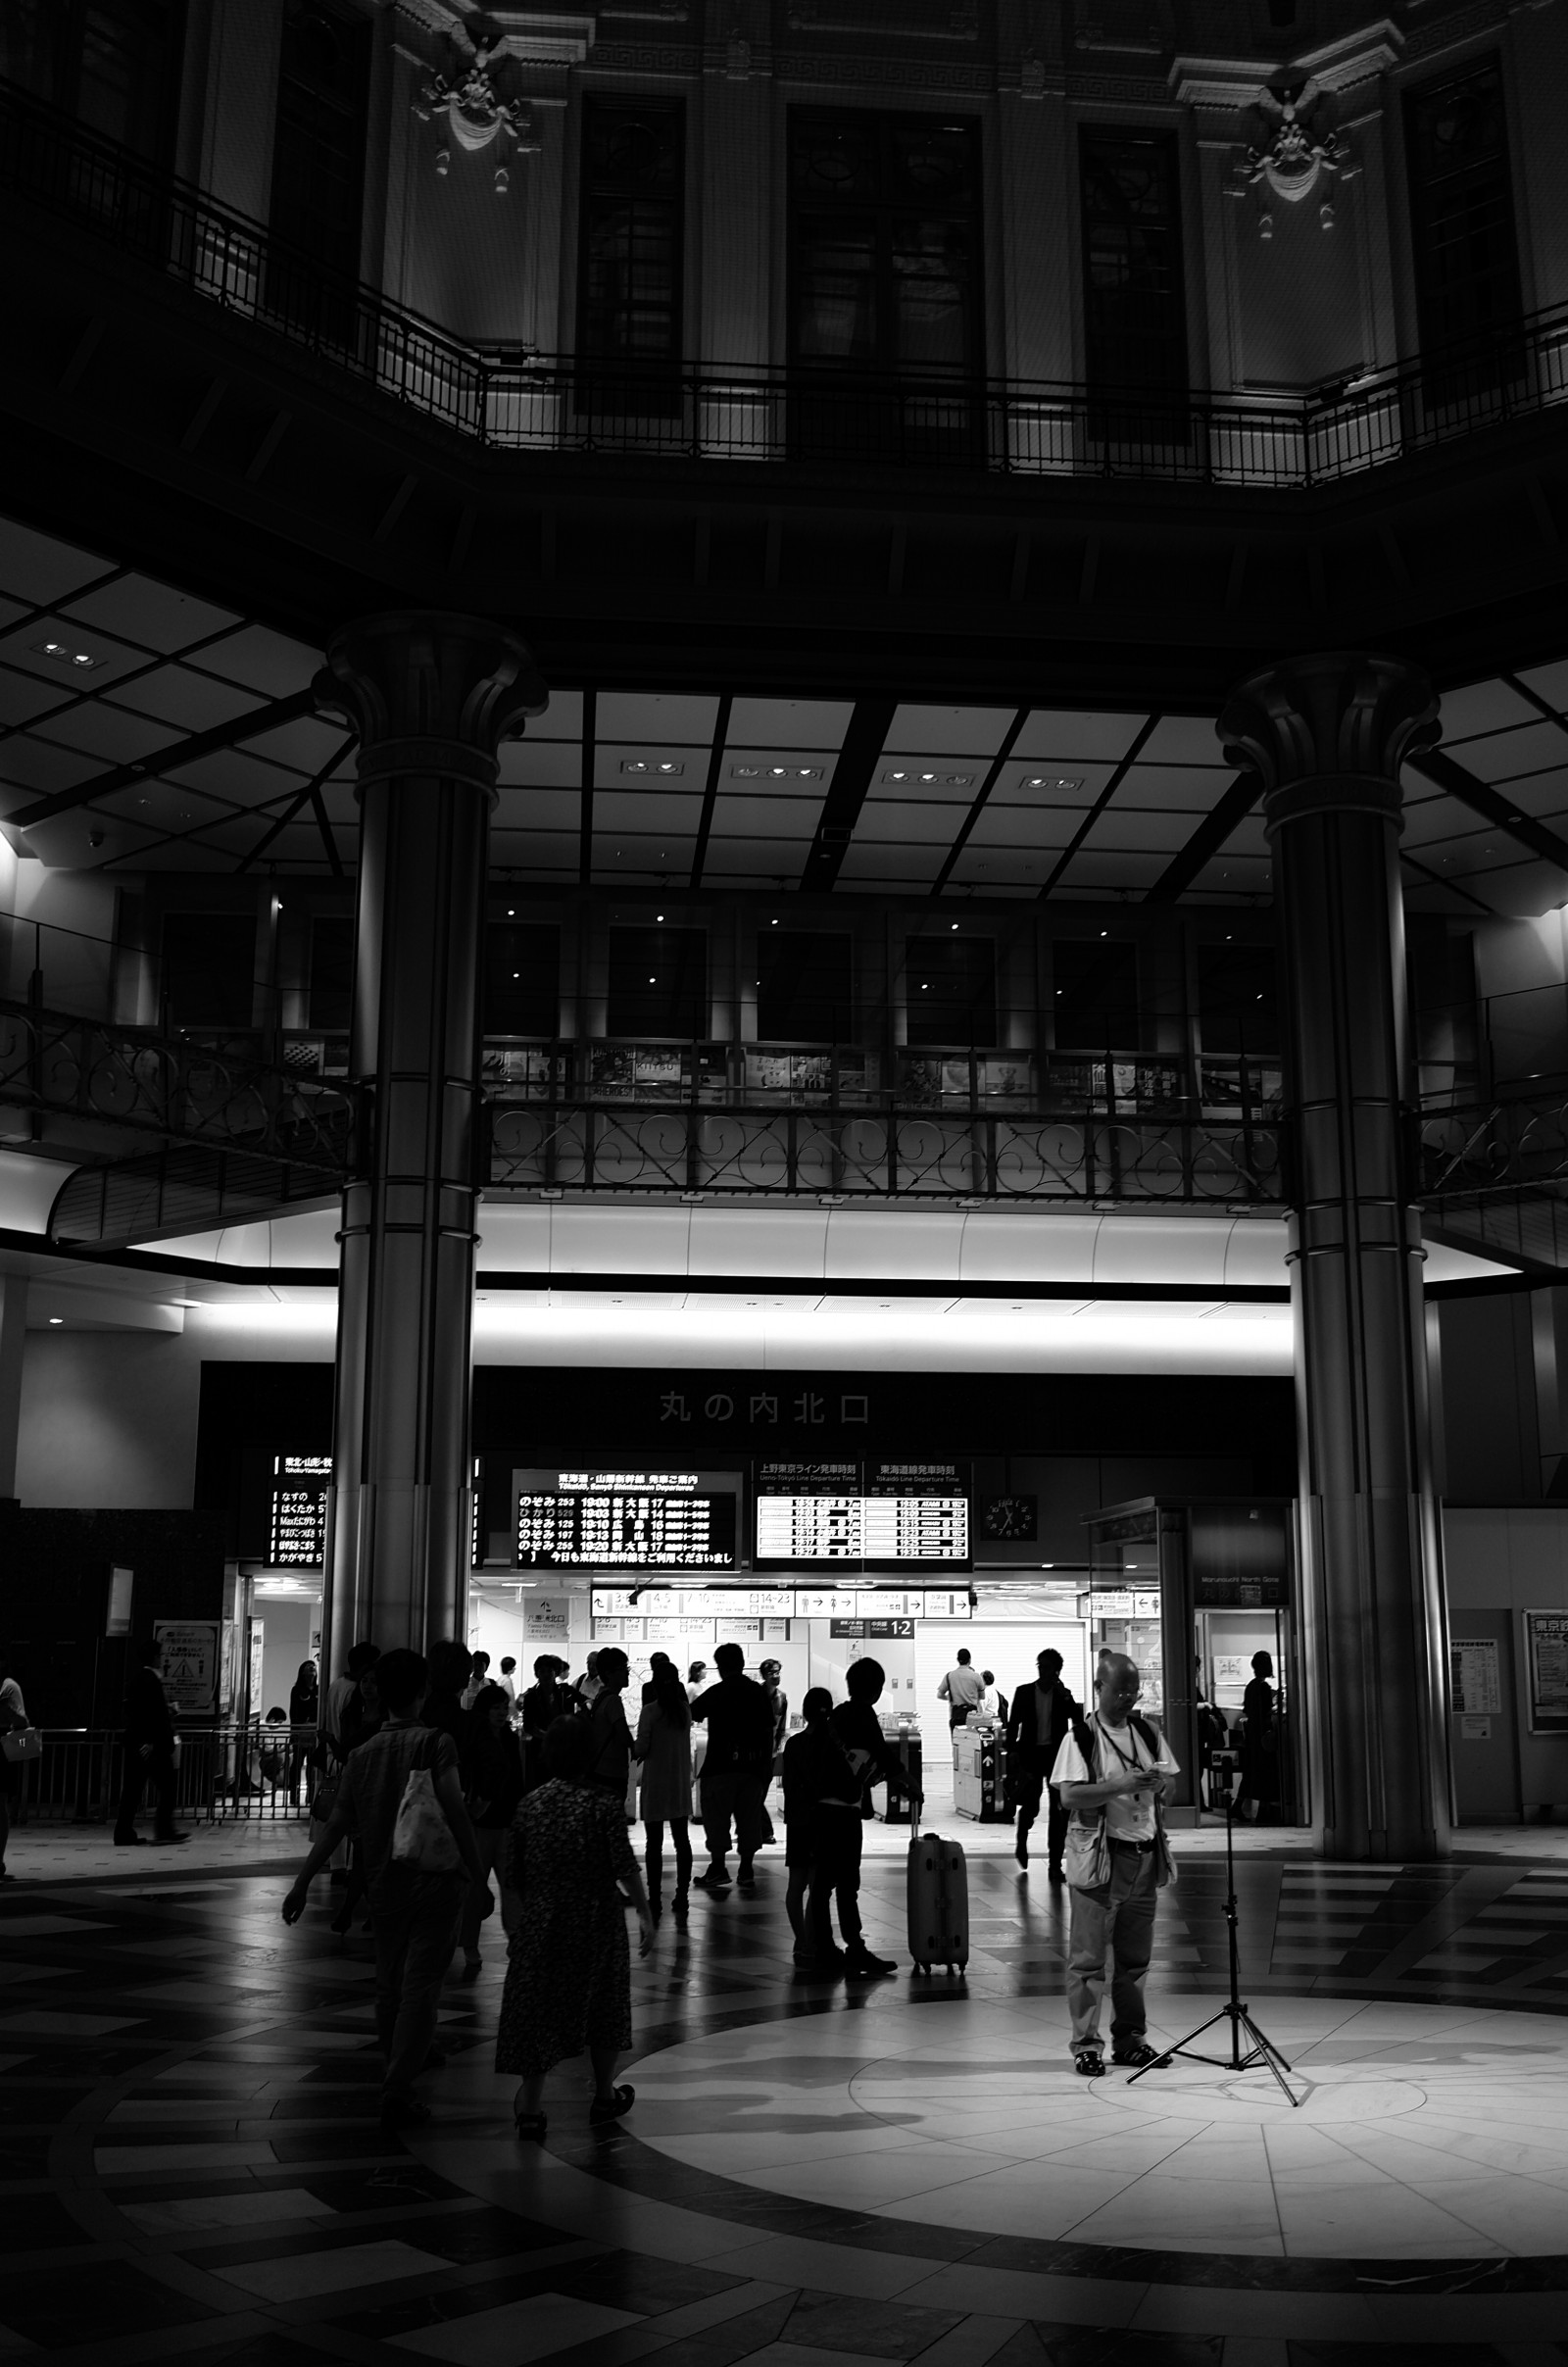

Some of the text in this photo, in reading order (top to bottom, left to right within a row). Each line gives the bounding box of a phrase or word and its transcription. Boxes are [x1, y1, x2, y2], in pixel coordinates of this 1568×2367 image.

[661, 1390, 869, 1424] 丸の内北口
[760, 1464, 857, 1474] 上野東京ライン発車時刻
[880, 1465, 956, 1475] 東海道線発車時刻
[282, 1493, 308, 1502] なすの
[519, 1497, 556, 1506] のぞみ
[581, 1498, 610, 1507] 19:00
[652, 1499, 663, 1507] 17
[281, 1504, 315, 1513] はくたか
[519, 1508, 555, 1517] ひかり
[581, 1508, 610, 1518] 19:03
[651, 1509, 663, 1519] 14
[519, 1518, 555, 1529] のぞみ
[581, 1519, 610, 1529] 19:10
[651, 1520, 663, 1530] 16
[518, 1529, 555, 1540] のぞみ
[580, 1530, 609, 1540] 19:13
[651, 1531, 663, 1541] 18
[518, 1542, 555, 1551] のぞみ
[580, 1541, 609, 1551] 19:20
[651, 1542, 662, 1552] 17
[279, 1553, 314, 1562] かがやき
